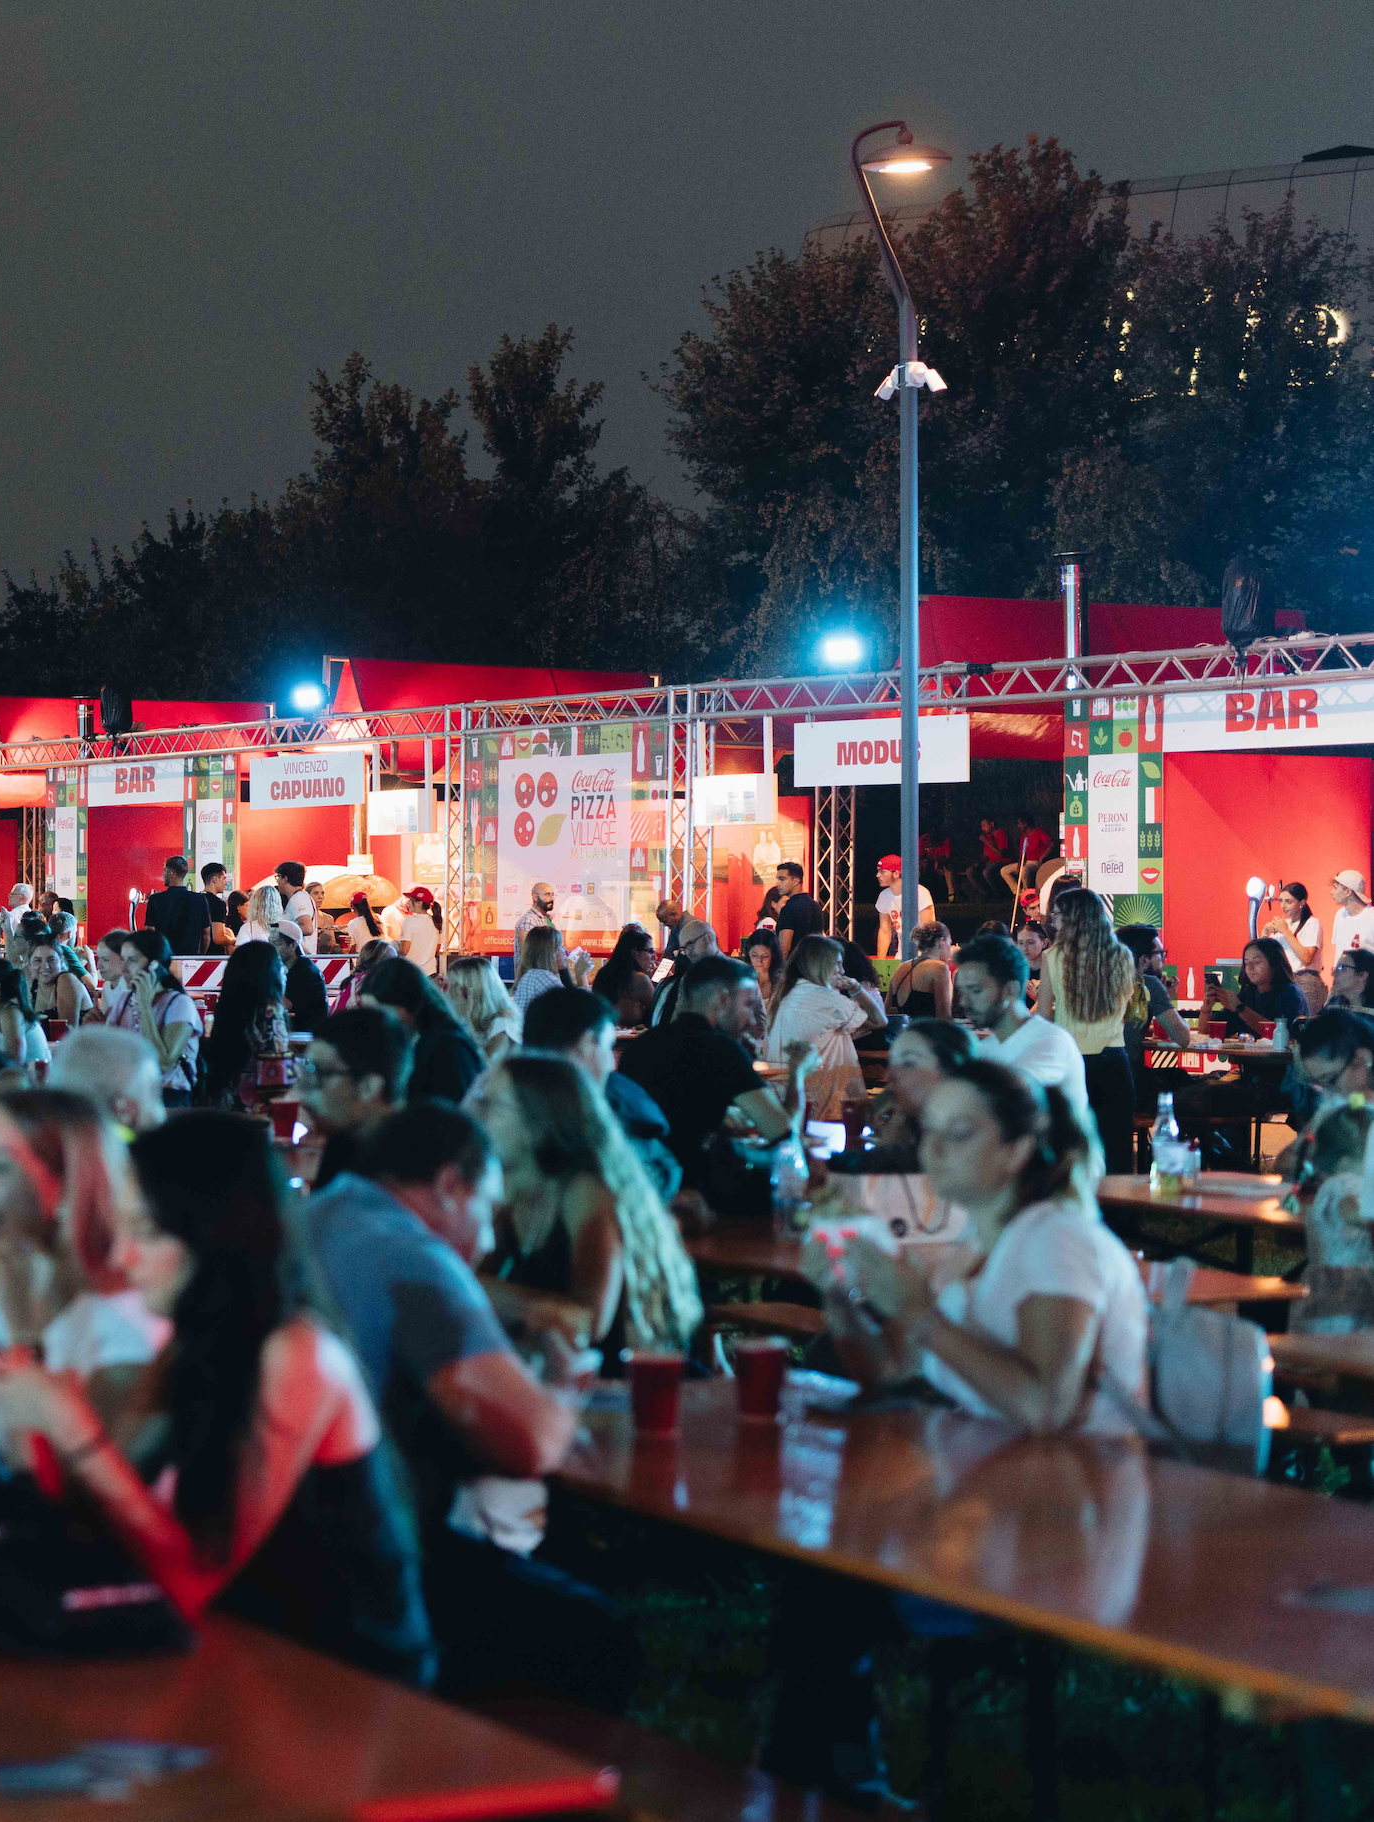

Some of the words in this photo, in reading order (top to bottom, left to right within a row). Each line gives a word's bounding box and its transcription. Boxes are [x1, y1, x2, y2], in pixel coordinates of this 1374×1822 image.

[1225, 688, 1319, 733] BAR
[837, 739, 921, 766] MODU
[115, 766, 156, 794] BAR
[283, 760, 329, 775] VINCENZO
[270, 776, 345, 801] CAPUANO
[571, 794, 617, 820] PIZZA
[1098, 812, 1128, 823] PERONI
[571, 820, 617, 846] VILLAGE
[570, 847, 617, 859] MILANO
